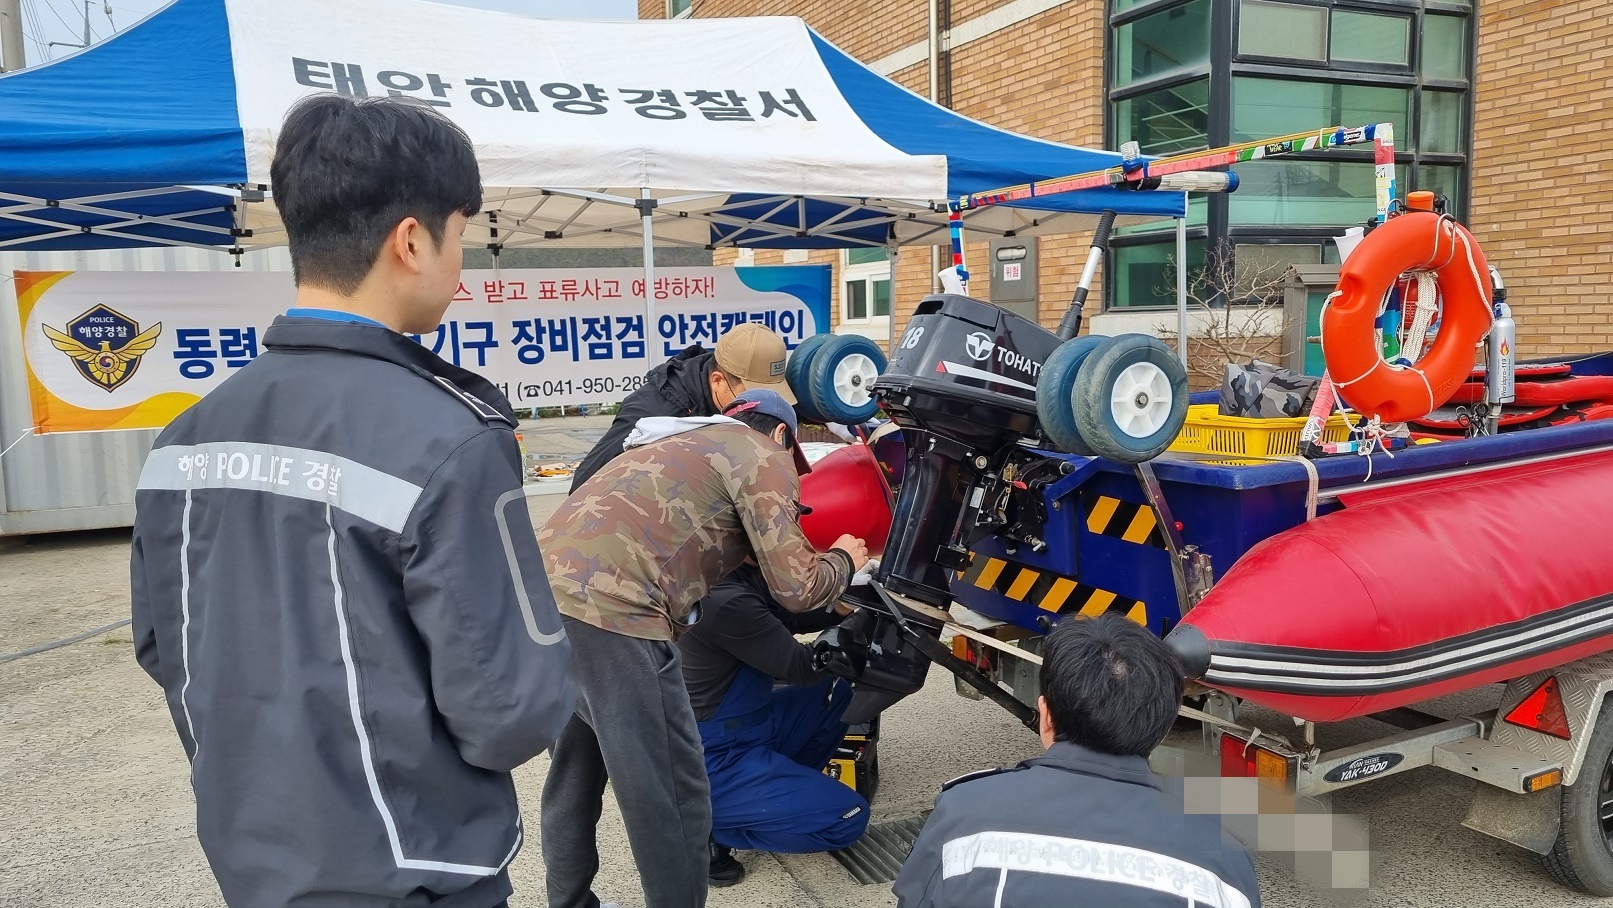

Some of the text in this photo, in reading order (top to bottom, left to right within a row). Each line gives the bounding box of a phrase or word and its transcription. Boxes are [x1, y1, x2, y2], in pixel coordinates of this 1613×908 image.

[1005, 265, 1019, 278] 위험
[484, 279, 528, 303] 받고
[538, 278, 622, 301] 표류사고
[632, 276, 715, 299] 예방하자!
[78, 326, 128, 338] 해양경찰
[405, 320, 499, 367] 기구
[511, 314, 645, 364] 장비점검
[900, 326, 925, 349] 18
[997, 346, 1043, 377] TOHAT
[302, 461, 342, 496] 경찰
[984, 836, 1212, 898] 해양 POLICE 경찰
